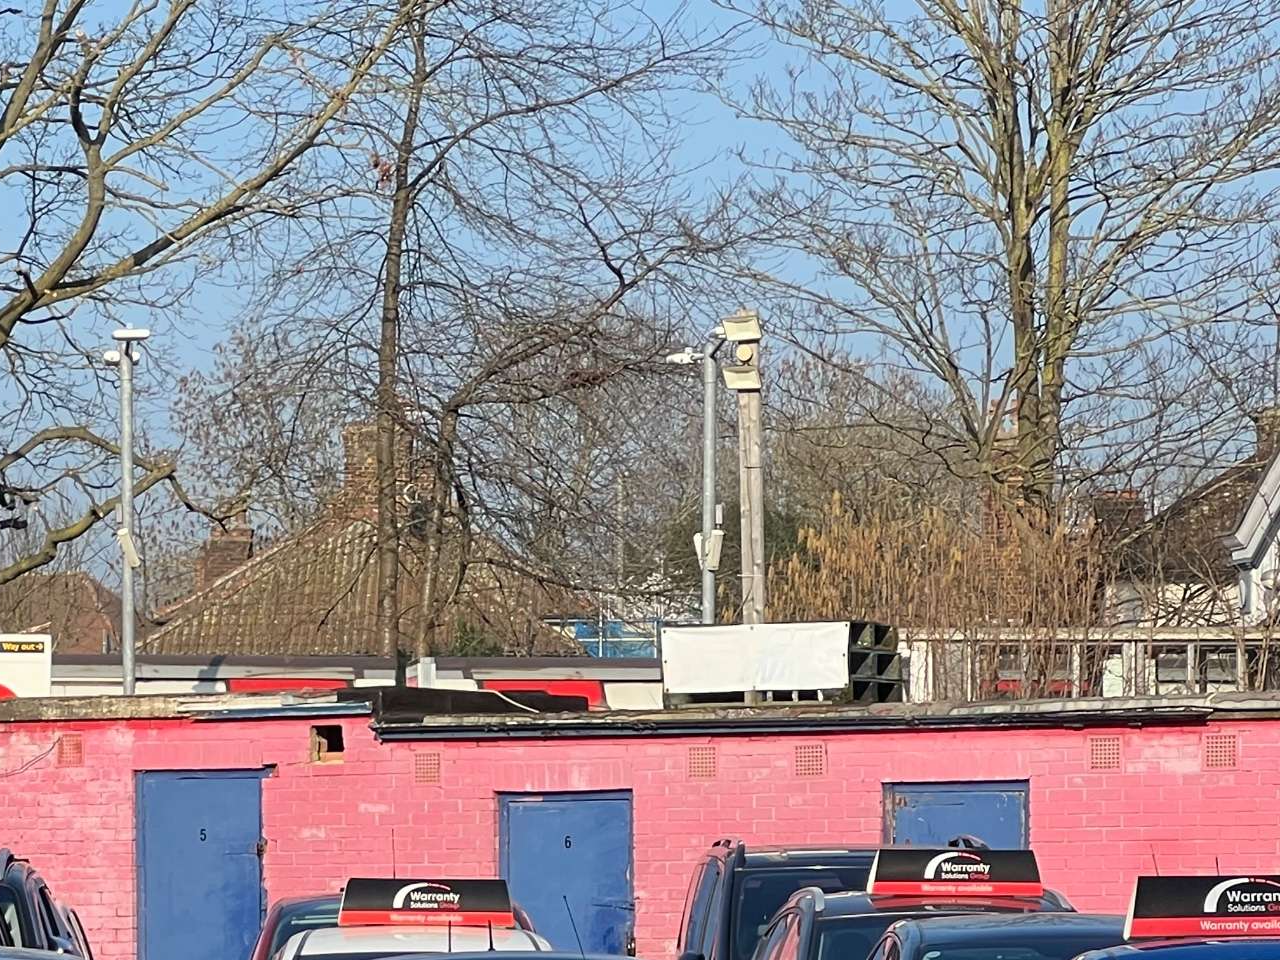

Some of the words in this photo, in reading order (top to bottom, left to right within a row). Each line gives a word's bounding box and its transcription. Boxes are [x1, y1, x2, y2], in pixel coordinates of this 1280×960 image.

[2, 642, 19, 652] Way
[21, 643, 35, 651] out
[200, 828, 207, 842] 5
[564, 835, 572, 849] 6
[941, 861, 990, 875] Warranty
[410, 891, 459, 904] Warranty
[1226, 890, 1280, 903] Warran
[1227, 903, 1266, 913] Solutions
[1200, 919, 1249, 932] Warranty
